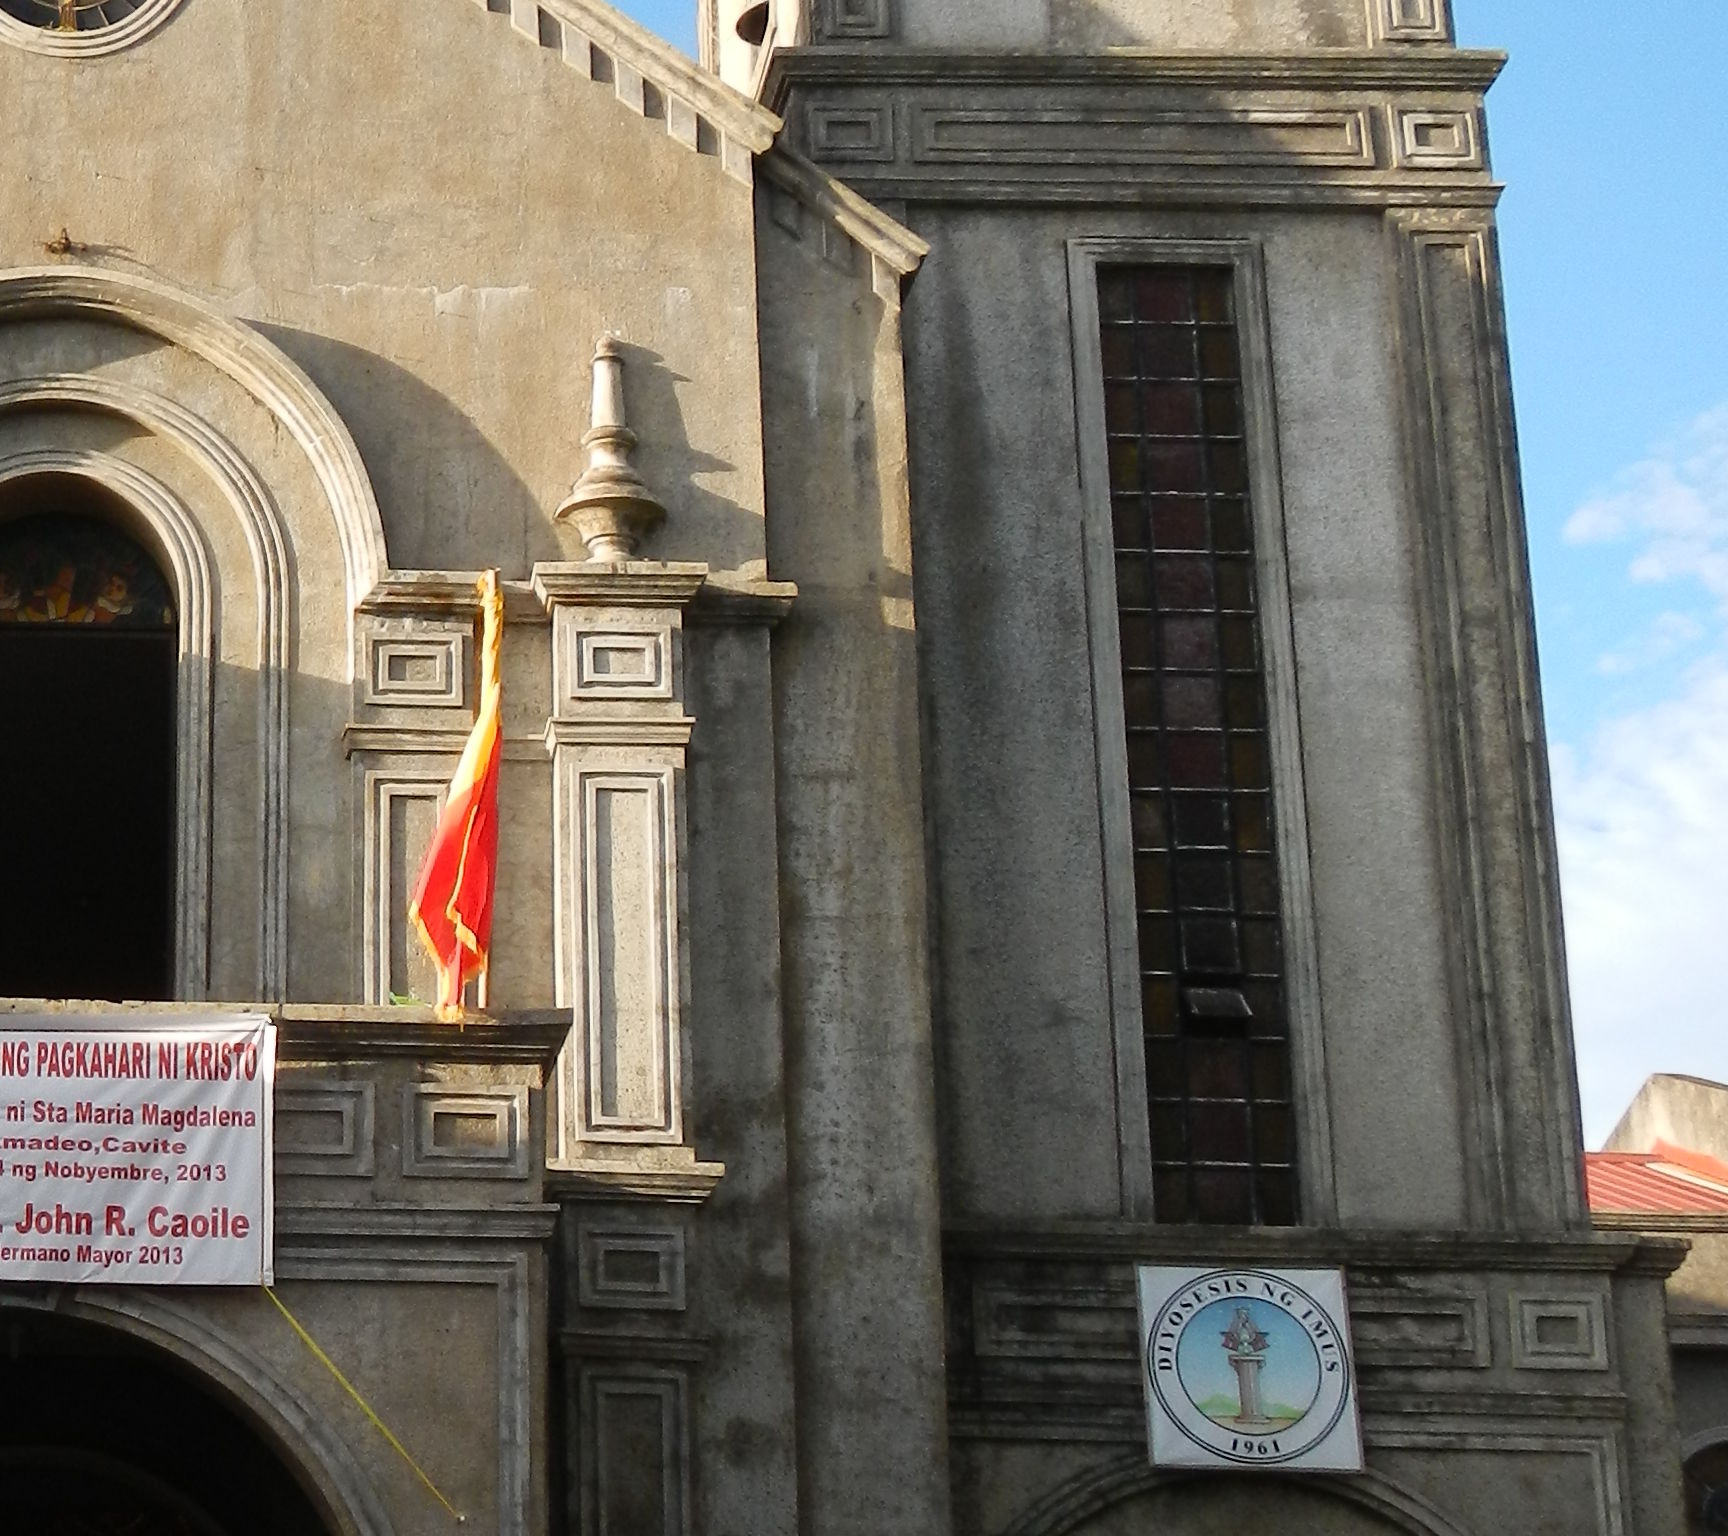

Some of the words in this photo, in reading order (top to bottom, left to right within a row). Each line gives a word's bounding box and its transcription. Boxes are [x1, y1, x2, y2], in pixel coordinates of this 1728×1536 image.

[2, 1041, 30, 1077] NG
[36, 1041, 151, 1079] PAGKAHARI
[158, 1042, 178, 1080] NI
[186, 1042, 257, 1081] KRISTO
[7, 1100, 25, 1122] ni
[33, 1101, 67, 1123] Sta
[76, 1102, 134, 1125] Maria
[142, 1103, 256, 1132] Magdalena
[12, 1163, 36, 1181] ng
[45, 1161, 169, 1184] Nobyembre,
[177, 1164, 227, 1182] 2013
[16, 1203, 92, 1235] John
[105, 1205, 135, 1237] R.
[148, 1206, 250, 1239] Caoile
[77, 1245, 132, 1268] Mayor
[139, 1246, 183, 1265] 2013
[1158, 1278, 1248, 1371] DIYOSESIS
[1261, 1282, 1296, 1307] NG
[1301, 1309, 1340, 1373] IMUS
[1231, 1438, 1280, 1455] 1961
